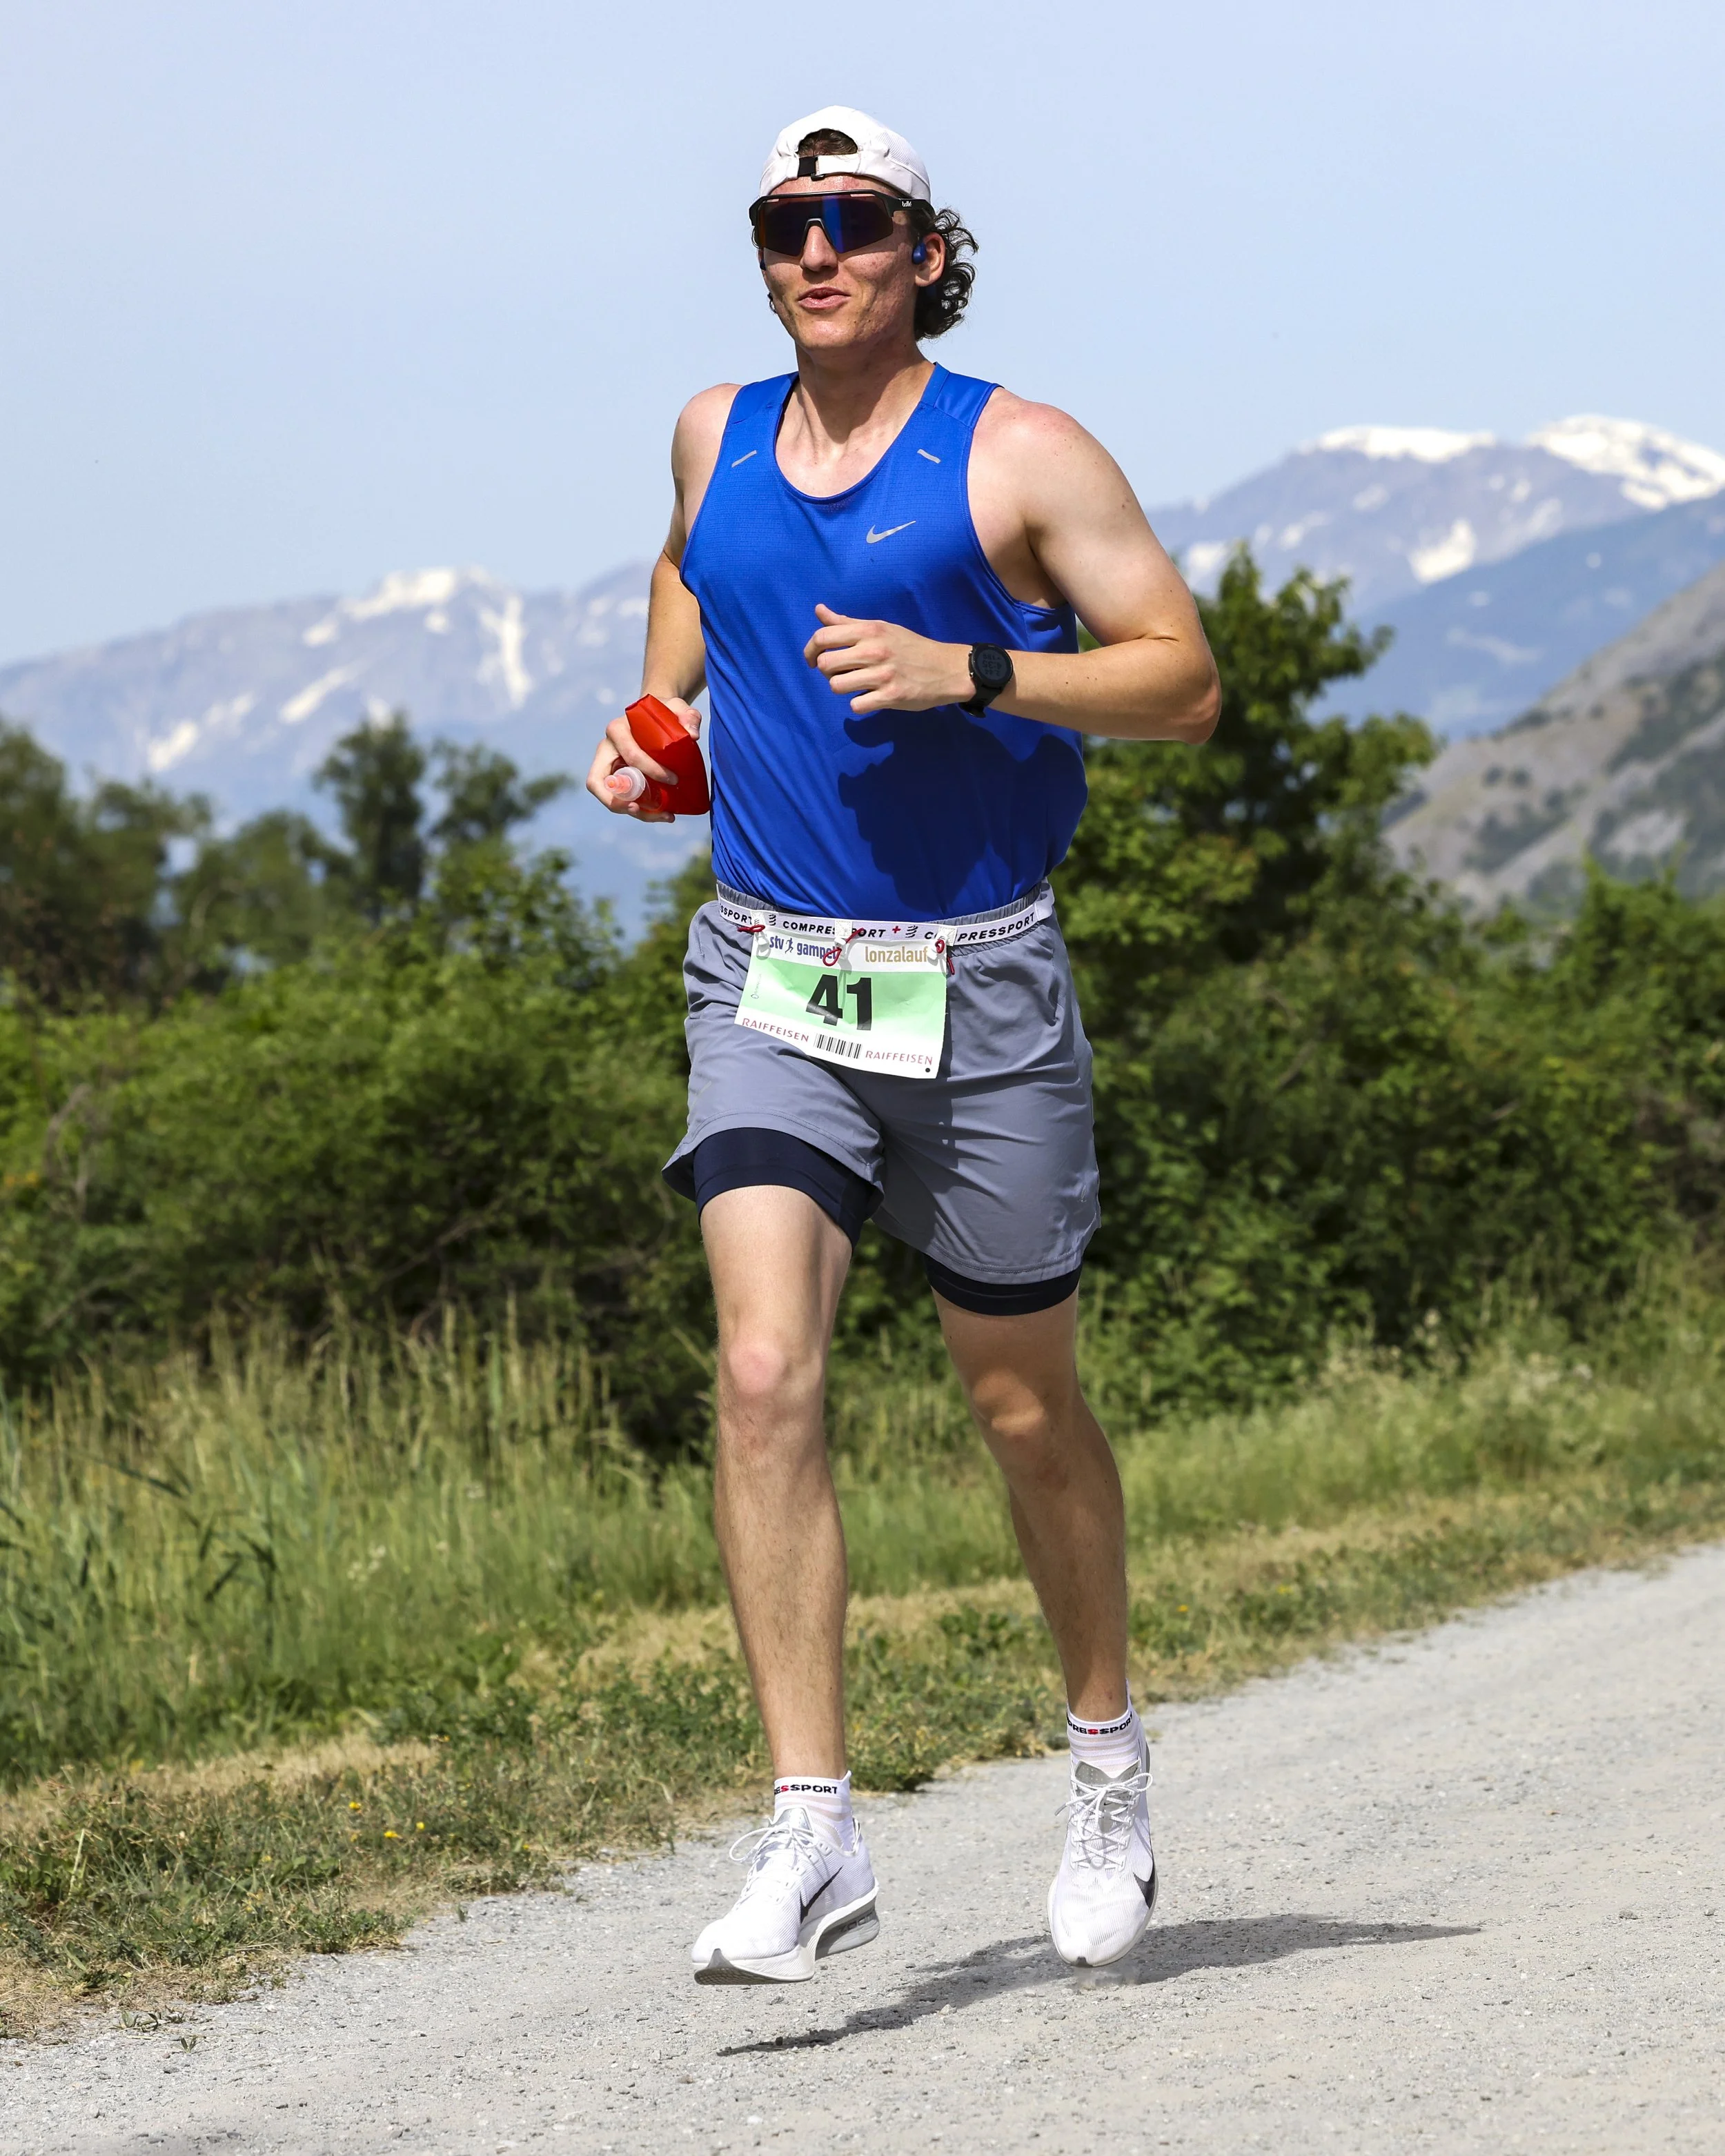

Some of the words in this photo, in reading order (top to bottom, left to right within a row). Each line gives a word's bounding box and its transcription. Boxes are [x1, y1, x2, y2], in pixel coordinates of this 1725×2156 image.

[925, 912, 1035, 942] CPRESSPORT
[769, 936, 784, 950] stv
[865, 946, 928, 962] lonzalauf
[806, 974, 872, 1031] 41
[742, 1018, 809, 1042] RAIFFEISEN
[865, 1050, 932, 1065] RAIFFEISEN
